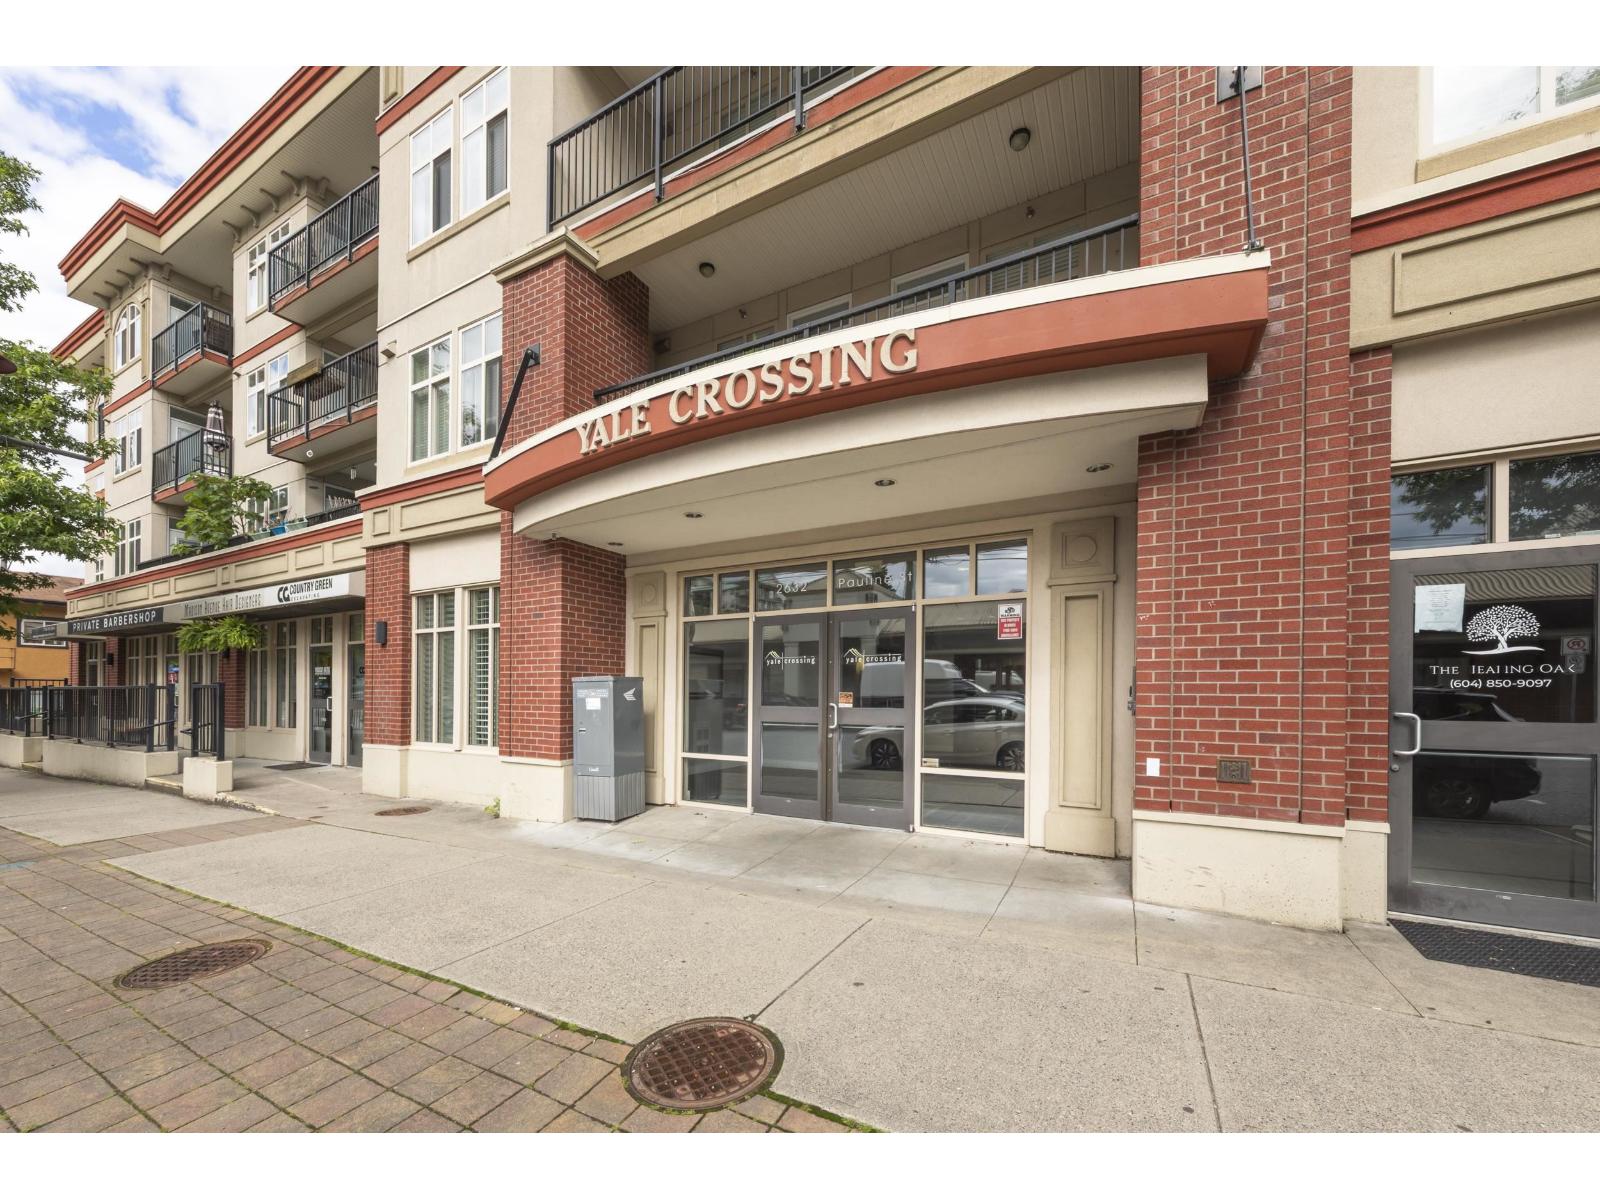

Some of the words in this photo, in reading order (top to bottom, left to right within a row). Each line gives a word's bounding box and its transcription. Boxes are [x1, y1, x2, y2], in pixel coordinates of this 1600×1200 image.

[576, 399, 652, 456] YALE
[668, 328, 919, 425] CROSSING
[290, 580, 315, 595] COUNTRY
[314, 577, 333, 590] GREEN
[776, 582, 807, 594] 2632
[838, 575, 891, 589] Pauline
[72, 620, 100, 632] PRIVATE
[103, 611, 156, 628] BARBERSHOP
[766, 656, 781, 666] yale
[784, 655, 816, 664] crossing
[845, 656, 862, 664] yale
[866, 653, 902, 662] crossing
[1429, 665, 1460, 675] THE
[1450, 678, 1482, 689] (604)
[1486, 678, 1552, 688] 850-9097
